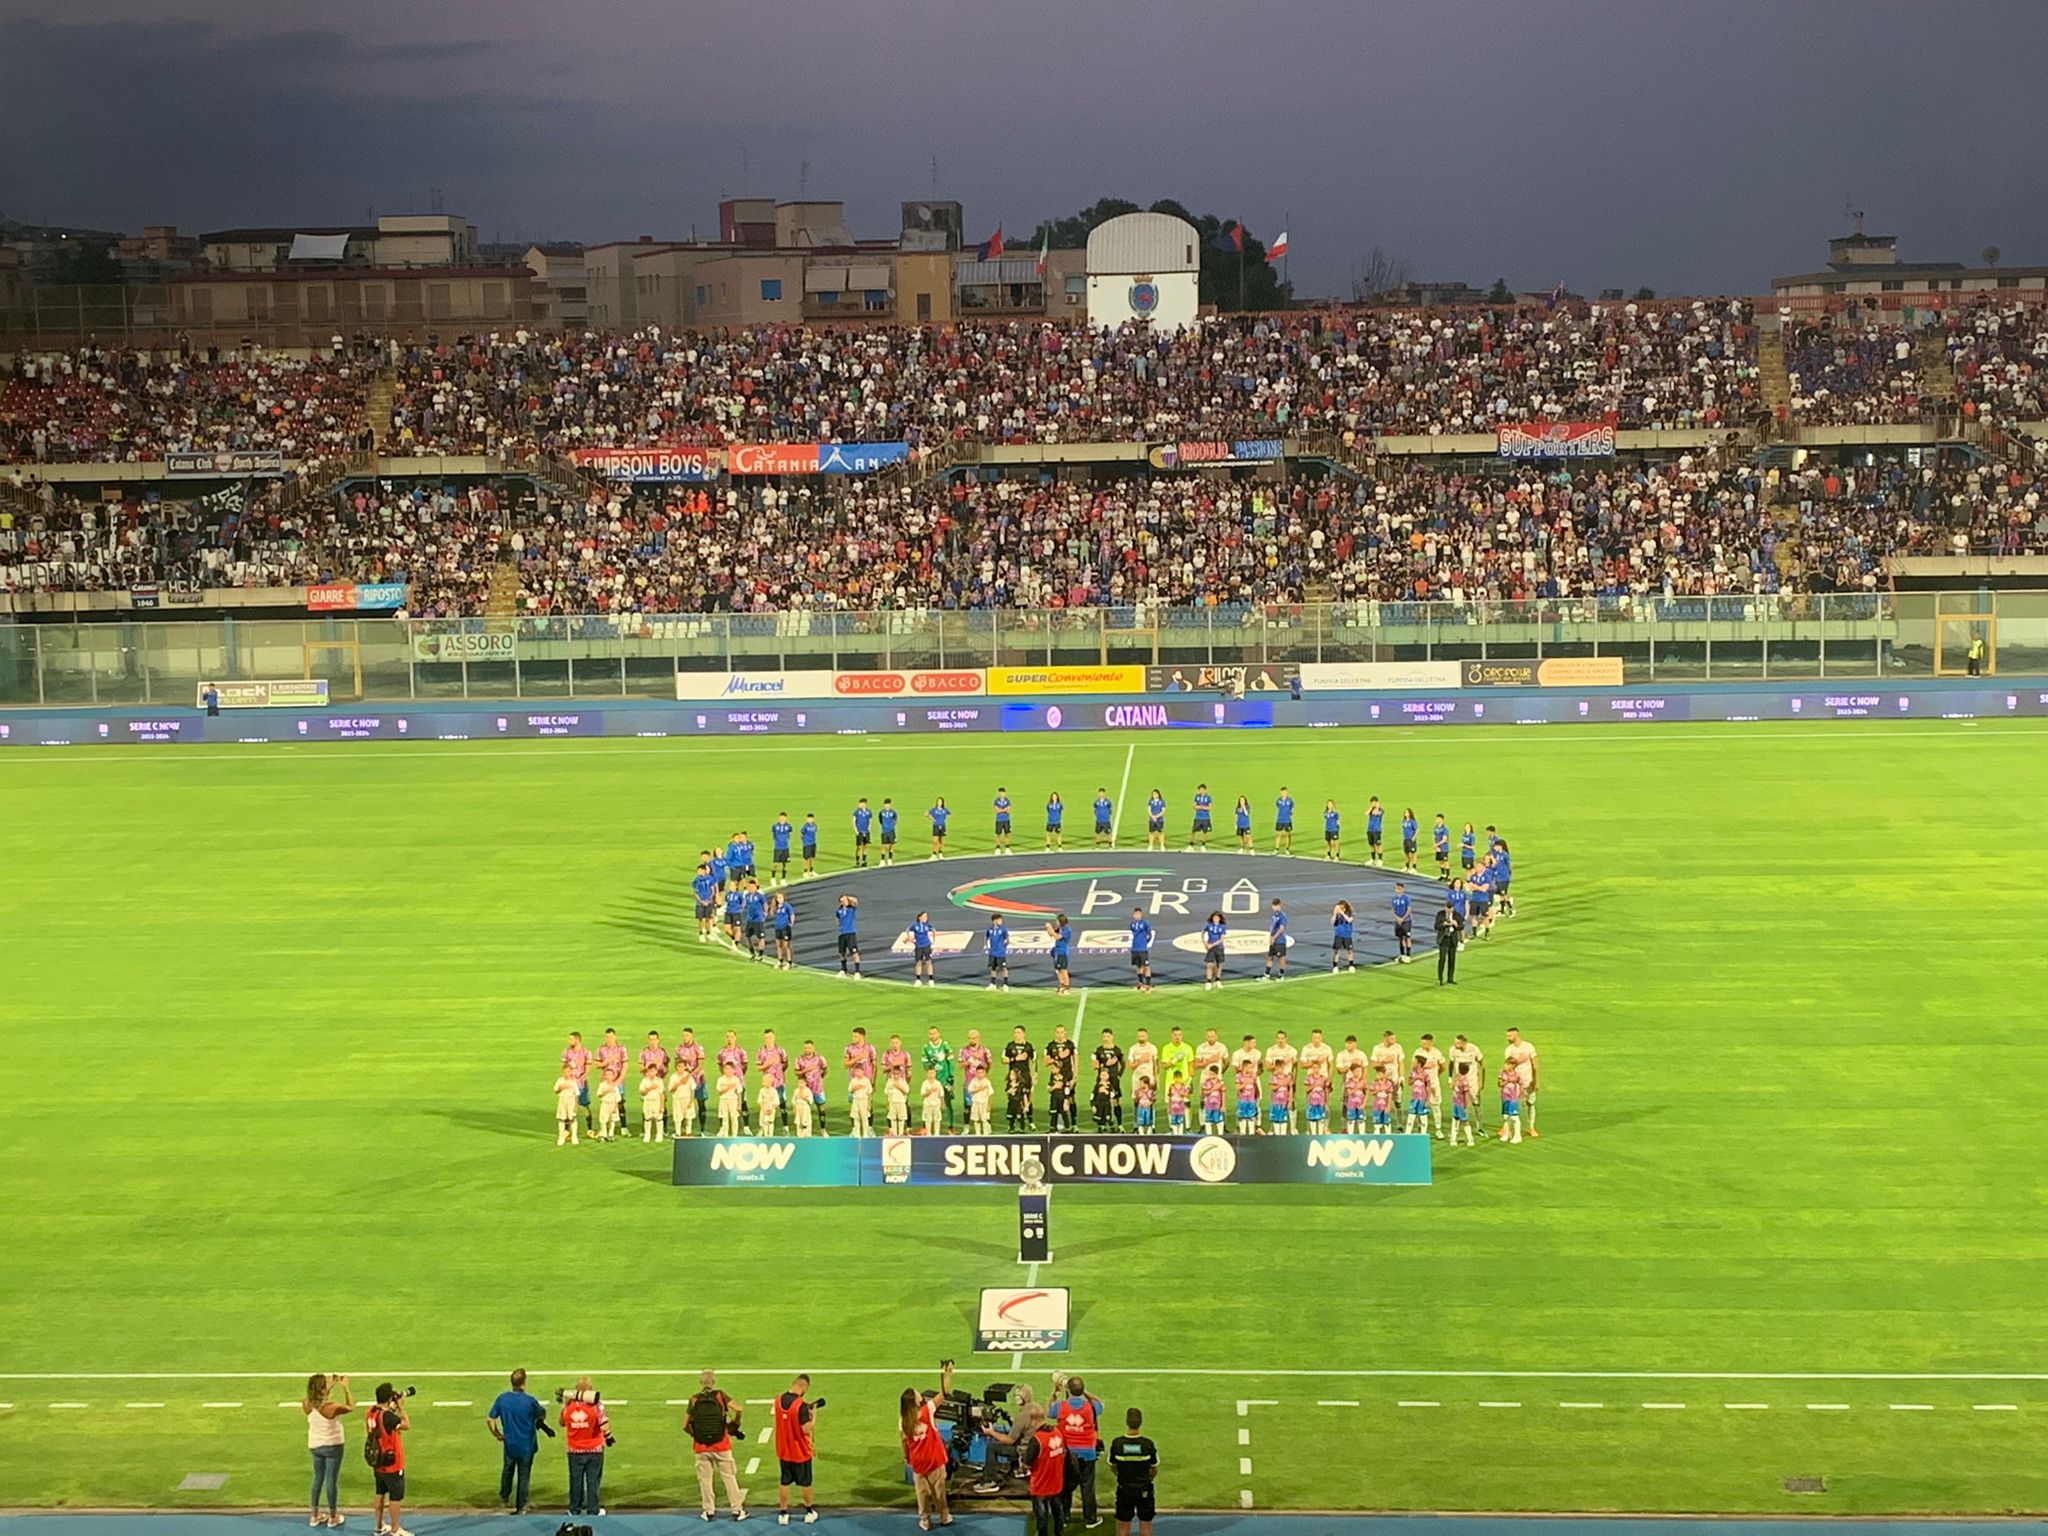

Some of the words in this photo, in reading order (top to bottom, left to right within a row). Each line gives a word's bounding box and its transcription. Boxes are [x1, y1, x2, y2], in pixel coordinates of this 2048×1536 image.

[1500, 426, 1614, 456] SUPPORTERS
[1178, 441, 1228, 460] ORGOGLIO
[1235, 440, 1282, 459] PASSIONE
[584, 454, 653, 477] SIMPSON
[659, 454, 702, 475] BOYS
[736, 446, 819, 473] CATANIA
[309, 589, 345, 603] GIARRE
[363, 587, 401, 601] RIPOSTO
[445, 634, 513, 651] ASSORO
[851, 678, 903, 689] BACCO
[928, 676, 979, 688] BACCO
[1006, 674, 1047, 683] SUPER
[1402, 703, 1425, 712] SERIE
[1427, 703, 1433, 712] C
[1433, 703, 1456, 712] NOW
[1611, 700, 1634, 709] SERIE
[1635, 700, 1642, 709] C
[1643, 700, 1665, 709] NOW
[1825, 697, 1849, 706] SERIE
[1849, 697, 1856, 706] C
[1857, 697, 1880, 706] NOW
[528, 716, 550, 725] SERIE
[551, 716, 557, 725] C
[558, 716, 579, 725] NOW
[728, 713, 750, 722] SERIE
[751, 713, 757, 722] C
[758, 713, 779, 722] NOW
[927, 710, 949, 719] SERIE
[951, 710, 957, 719] C
[957, 710, 978, 719] NOW
[1105, 705, 1168, 727] CATANIA
[129, 722, 152, 732] SERIE
[152, 722, 158, 732] C
[159, 722, 180, 732] NOW
[329, 719, 351, 728] SERIE
[352, 719, 358, 728] C
[358, 719, 379, 728] NOW
[1088, 878, 1260, 893] LEGA
[1081, 891, 1260, 915] PRO
[711, 1142, 796, 1171] NOW
[944, 1144, 1042, 1176] SERIE
[1051, 1143, 1075, 1175] C
[1084, 1143, 1171, 1175] NOW
[1307, 1139, 1394, 1168] NOW
[885, 1174, 908, 1183] NOW
[981, 1330, 1042, 1338] SERIE
[1048, 1330, 1064, 1338] C
[987, 1340, 1055, 1350] NOW
